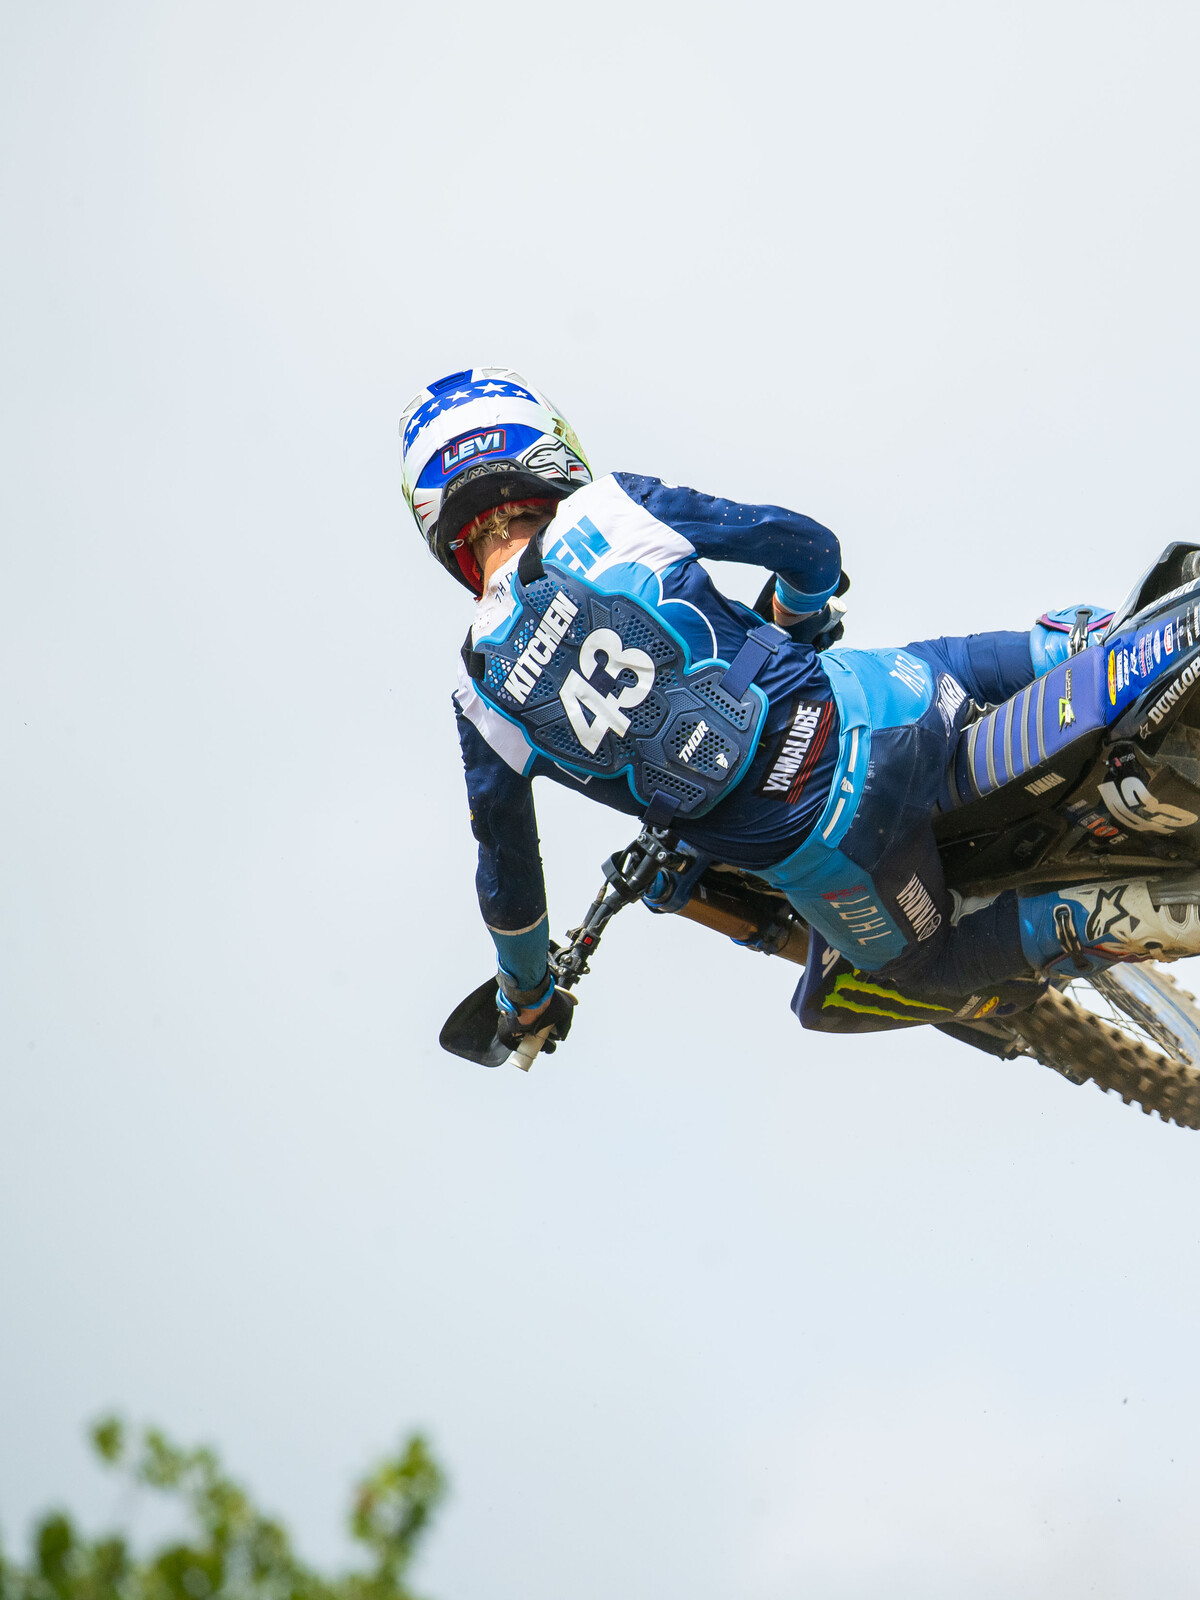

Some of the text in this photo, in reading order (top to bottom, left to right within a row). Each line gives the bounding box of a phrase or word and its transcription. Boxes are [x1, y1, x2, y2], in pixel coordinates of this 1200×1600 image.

[443, 431, 501, 469] LEVI
[502, 590, 579, 705] KITCHEN
[559, 627, 656, 755] 43
[678, 720, 709, 763] THOR
[762, 701, 822, 794] YAMALUBE
[1024, 772, 1067, 797] YAMAHA
[896, 873, 937, 934] YAMAHA
